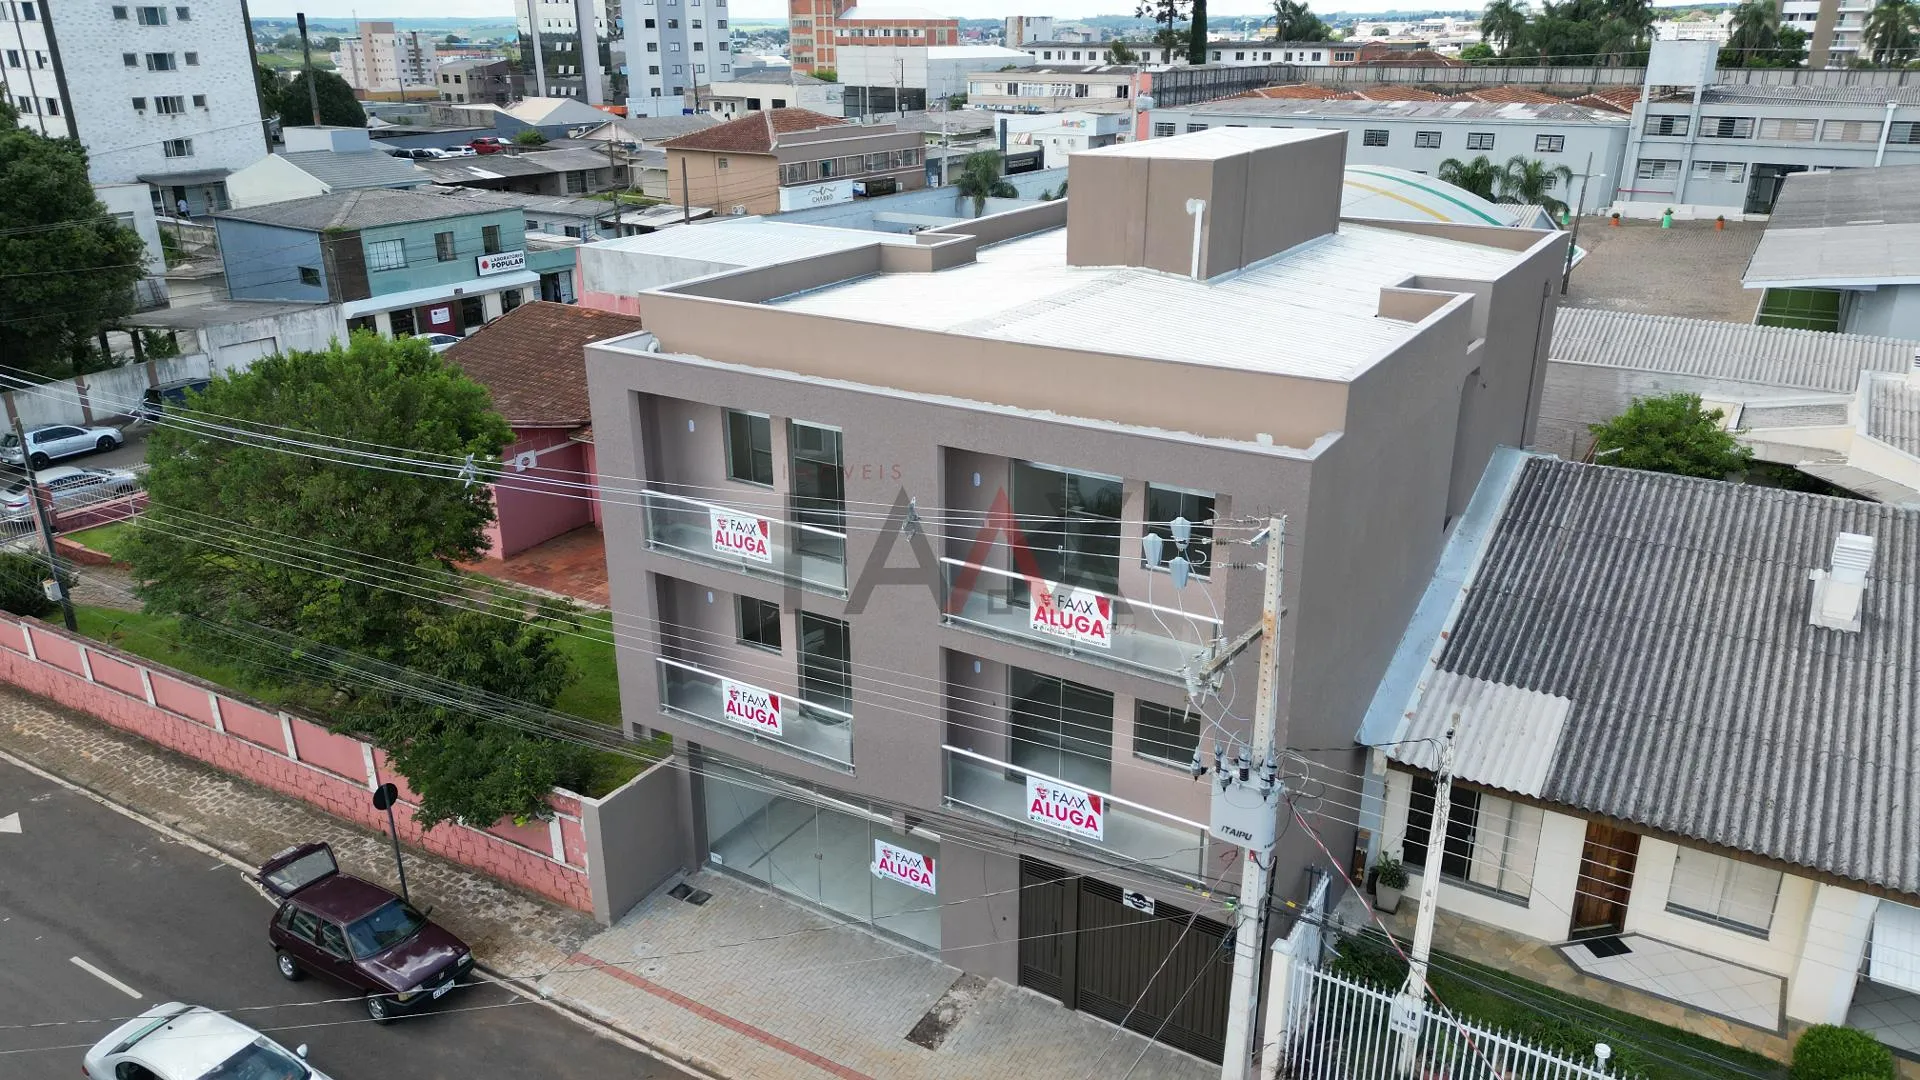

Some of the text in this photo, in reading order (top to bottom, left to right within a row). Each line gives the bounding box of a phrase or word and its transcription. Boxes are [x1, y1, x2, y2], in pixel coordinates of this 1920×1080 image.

[491, 258, 524, 269] POPULAR
[715, 530, 767, 555] ALUGA
[1034, 605, 1105, 638] ALUGA
[726, 699, 778, 728] ALUGA
[1031, 798, 1098, 832] ALUGA
[1221, 825, 1253, 841] ITAIPU
[879, 857, 931, 887] ALUGA
